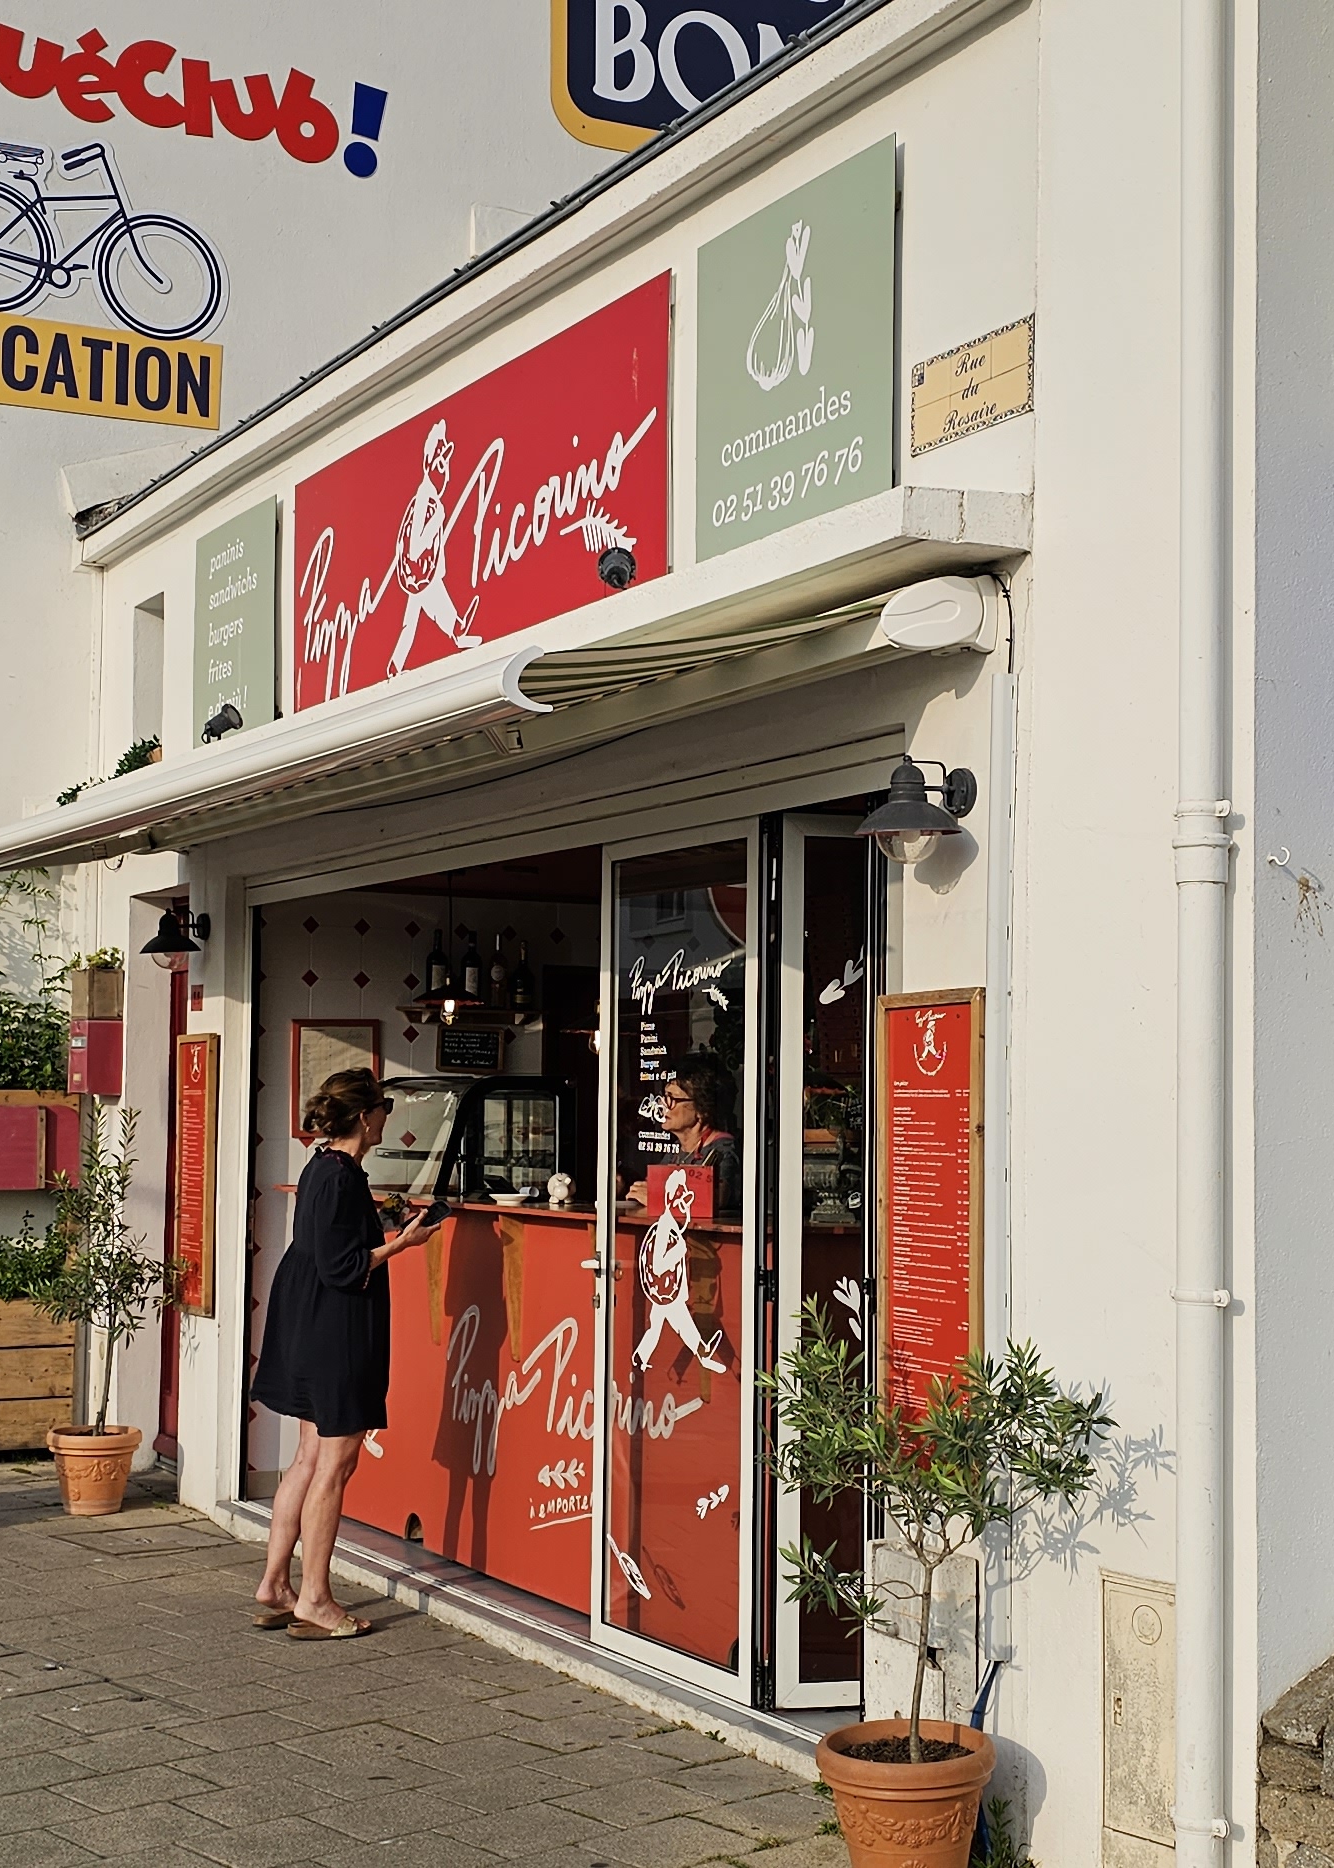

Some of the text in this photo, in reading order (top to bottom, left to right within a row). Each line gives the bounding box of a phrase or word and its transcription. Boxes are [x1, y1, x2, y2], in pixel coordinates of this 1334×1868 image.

[955, 353, 985, 377] Rue
[961, 377, 979, 400] du
[721, 386, 852, 467] commandes
[943, 401, 997, 433] Rosaire
[712, 435, 864, 528] 02 51 39 76 76
[208, 538, 245, 580] paninis
[300, 407, 657, 701] Pizza Picorino
[208, 567, 258, 610] sandwichs
[208, 617, 244, 647] burgers
[208, 659, 233, 684] frites
[629, 949, 731, 1015] Pizza Picorino
[447, 1305, 704, 1477] Pizza Picrino
